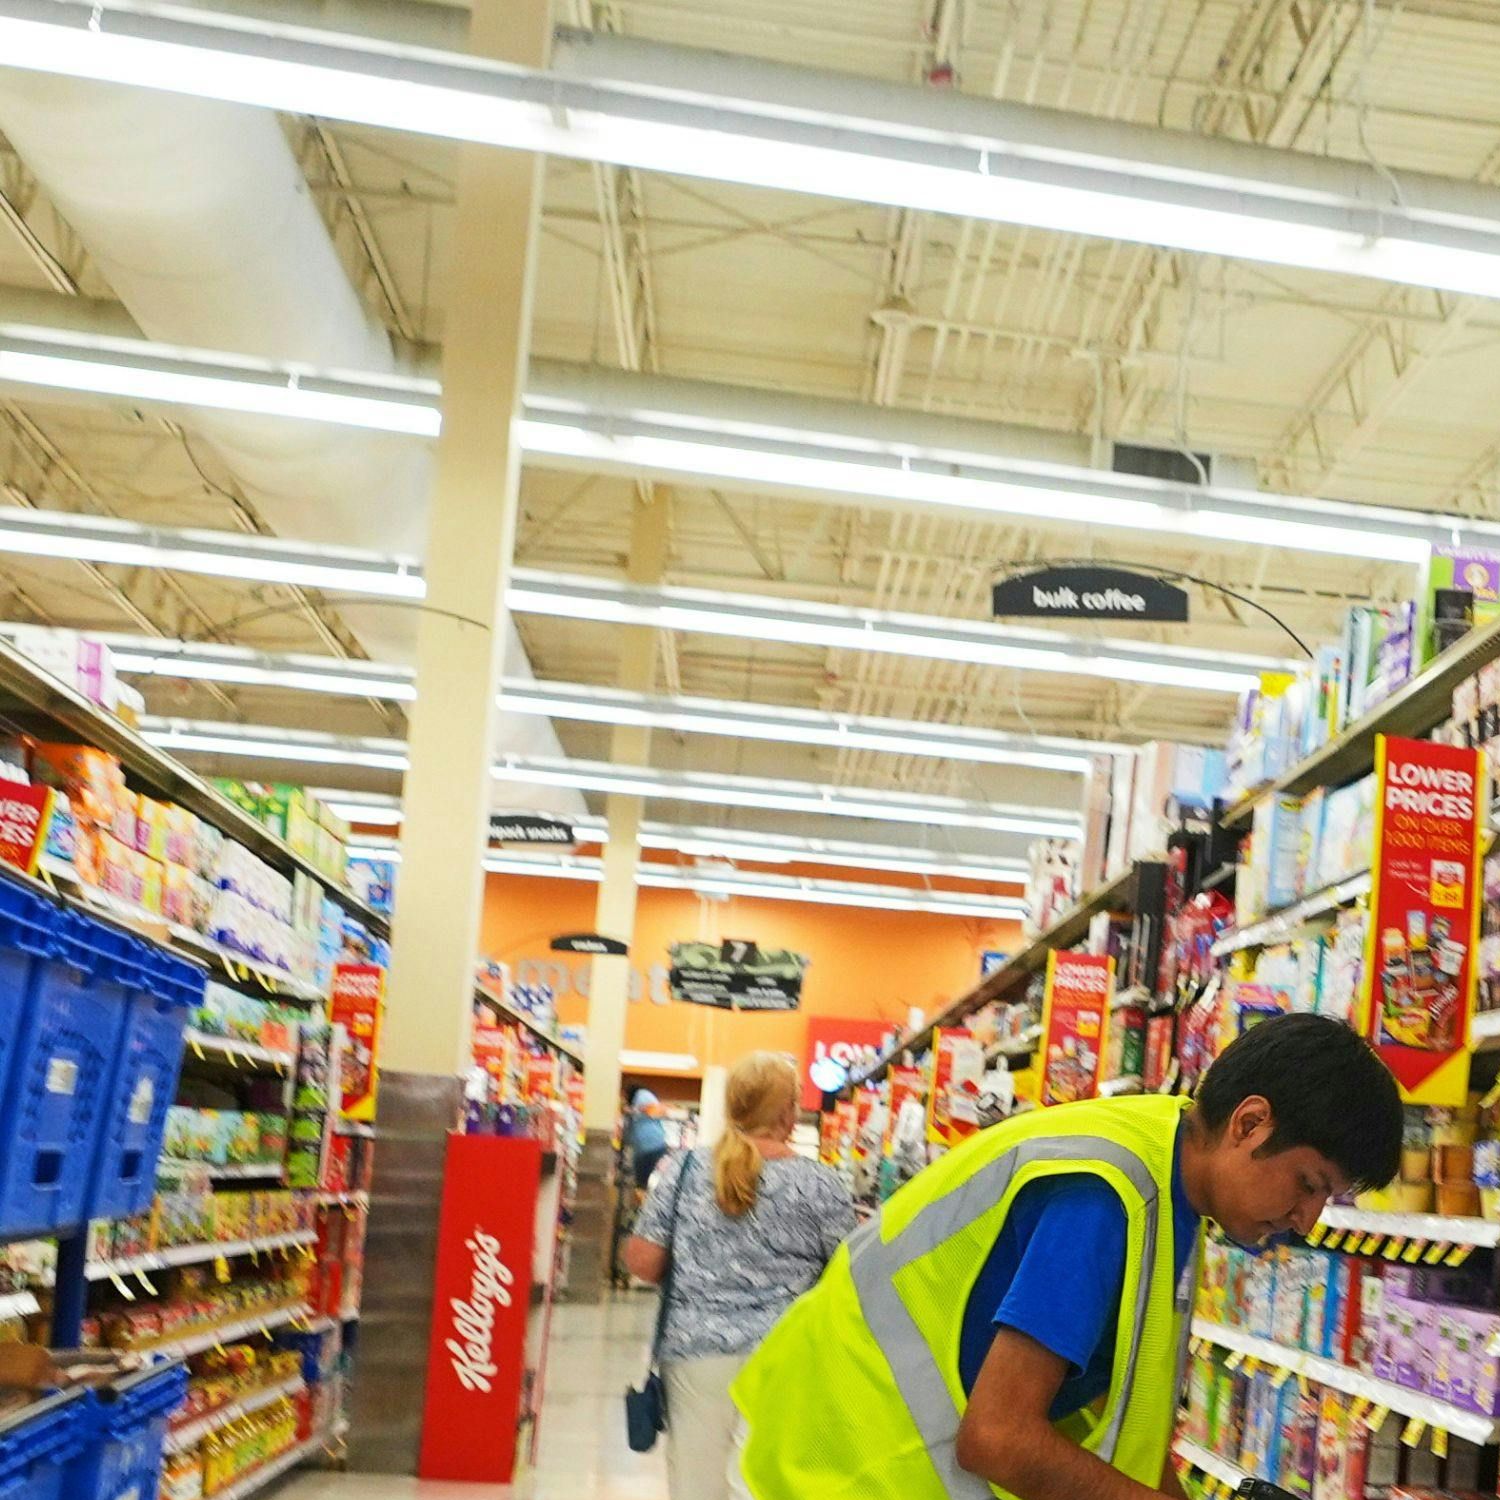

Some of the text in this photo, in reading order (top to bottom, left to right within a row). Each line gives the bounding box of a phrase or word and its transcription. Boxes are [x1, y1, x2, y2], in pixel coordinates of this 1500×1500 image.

[1033, 586, 1147, 612] bulk coffee
[1388, 760, 1473, 795] LOWER
[1385, 786, 1473, 821] PRICES
[1393, 813, 1464, 837] ON OVER
[445, 1224, 515, 1393] Kellogg's
